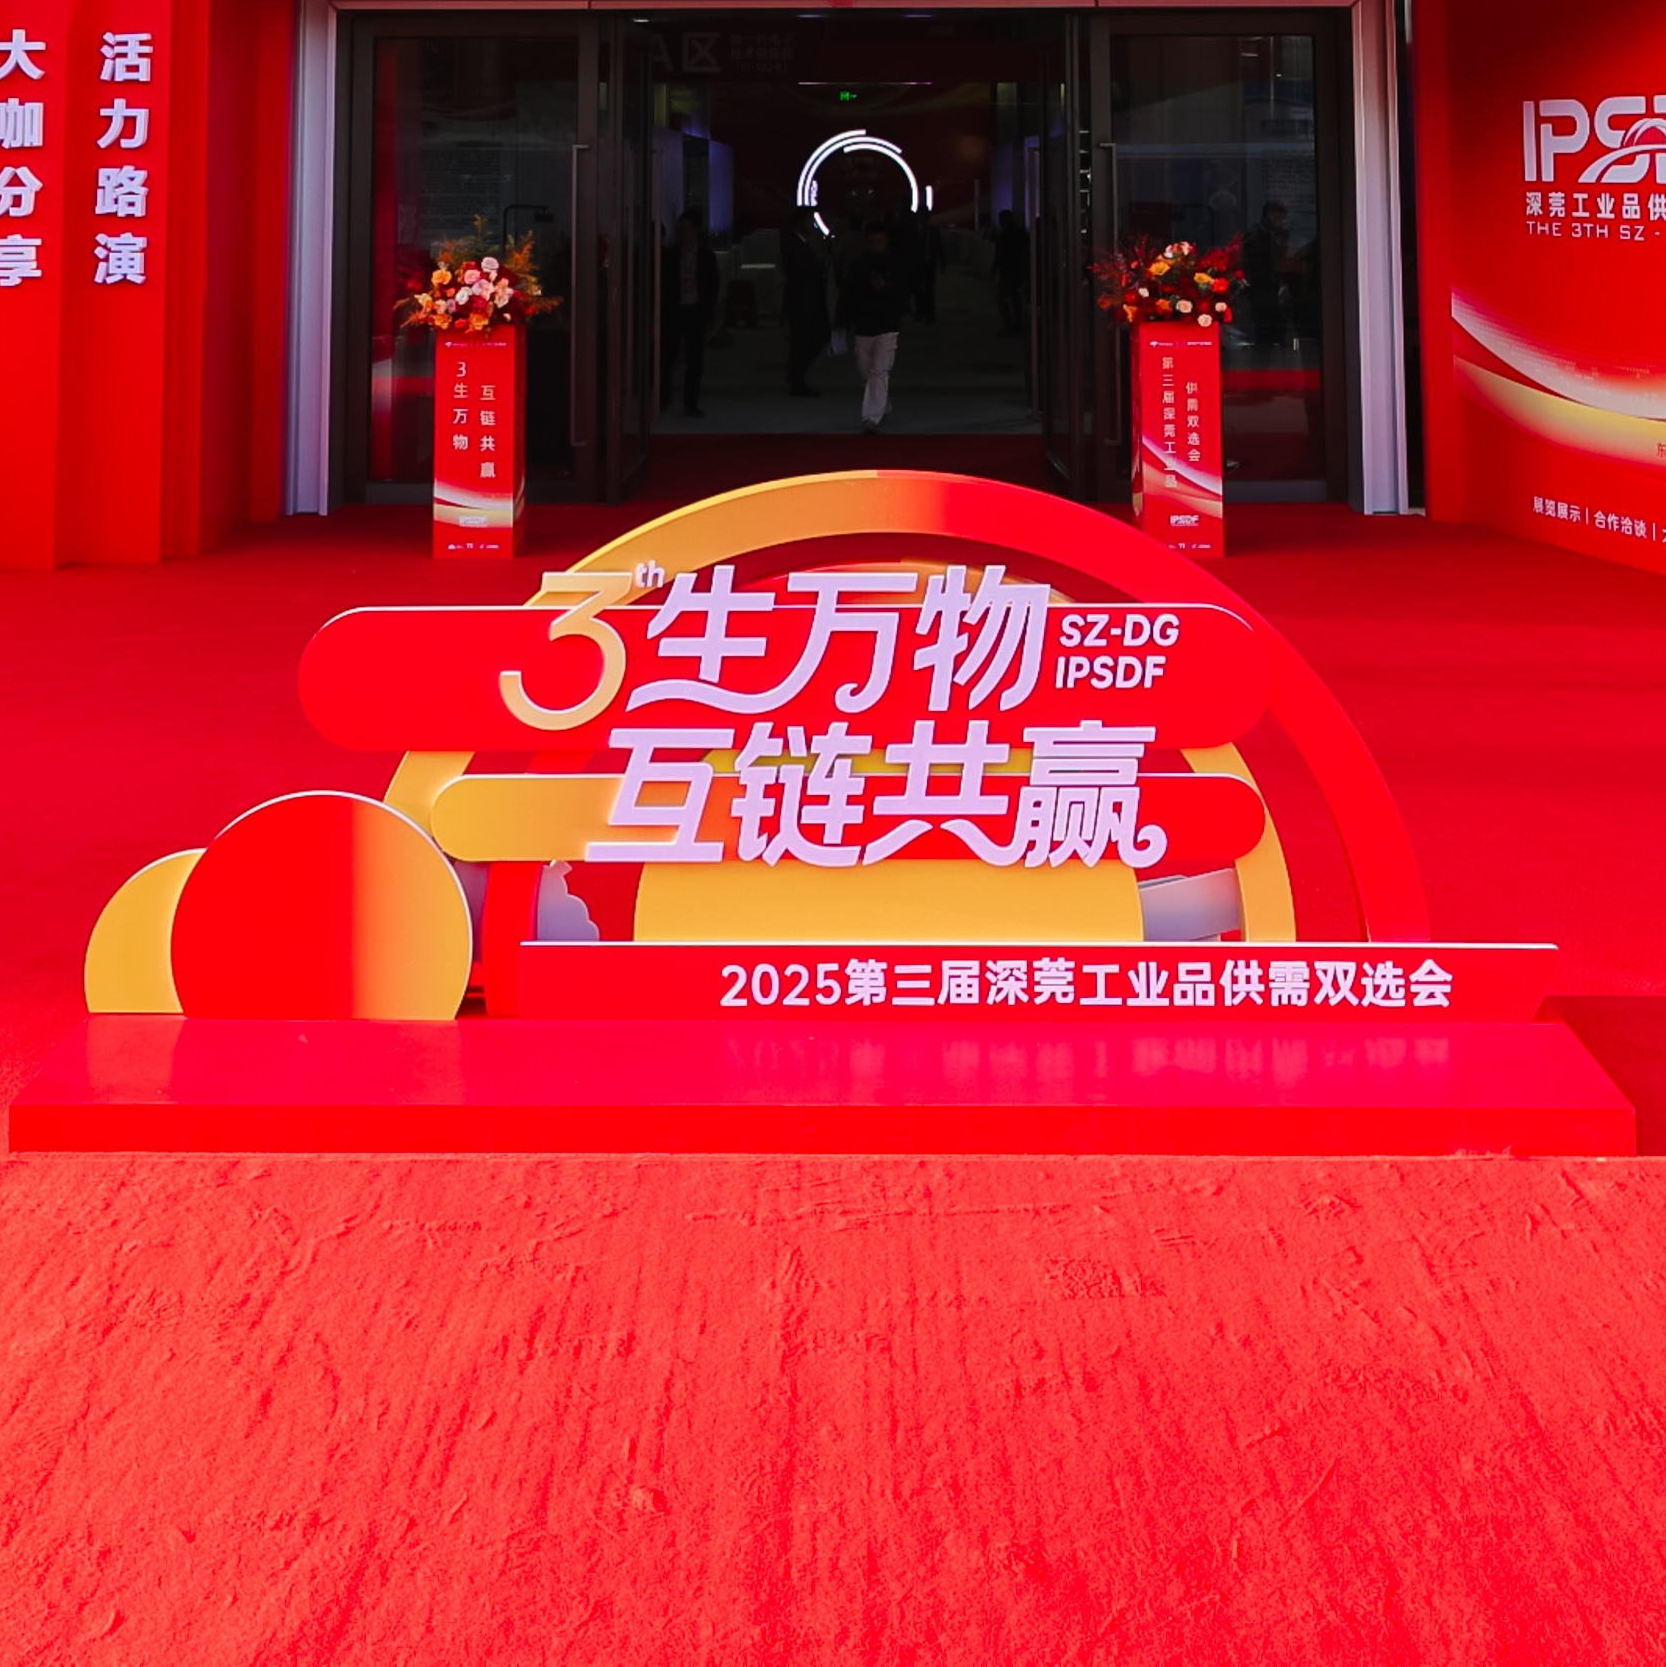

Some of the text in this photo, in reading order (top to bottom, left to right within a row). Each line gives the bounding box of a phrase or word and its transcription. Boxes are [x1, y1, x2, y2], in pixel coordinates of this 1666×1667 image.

[93, 31, 153, 286] 活力路演
[1526, 220, 1562, 237] THE
[1571, 223, 1609, 239] 3TH
[453, 362, 469, 451] 3生万物
[480, 385, 495, 478] 互链共赢
[1162, 357, 1177, 488] 第三届深莞工业品
[1186, 382, 1201, 462] 供需双选会
[1532, 495, 1581, 523] 展览展示
[1593, 510, 1647, 539] 合作洽谈
[1059, 613, 1180, 648] SZ-DG
[1055, 655, 1166, 689] IPSDF
[585, 720, 1168, 868] 互链共赢
[720, 958, 1453, 1007] 2025第三届深莞工业品供需双选会
